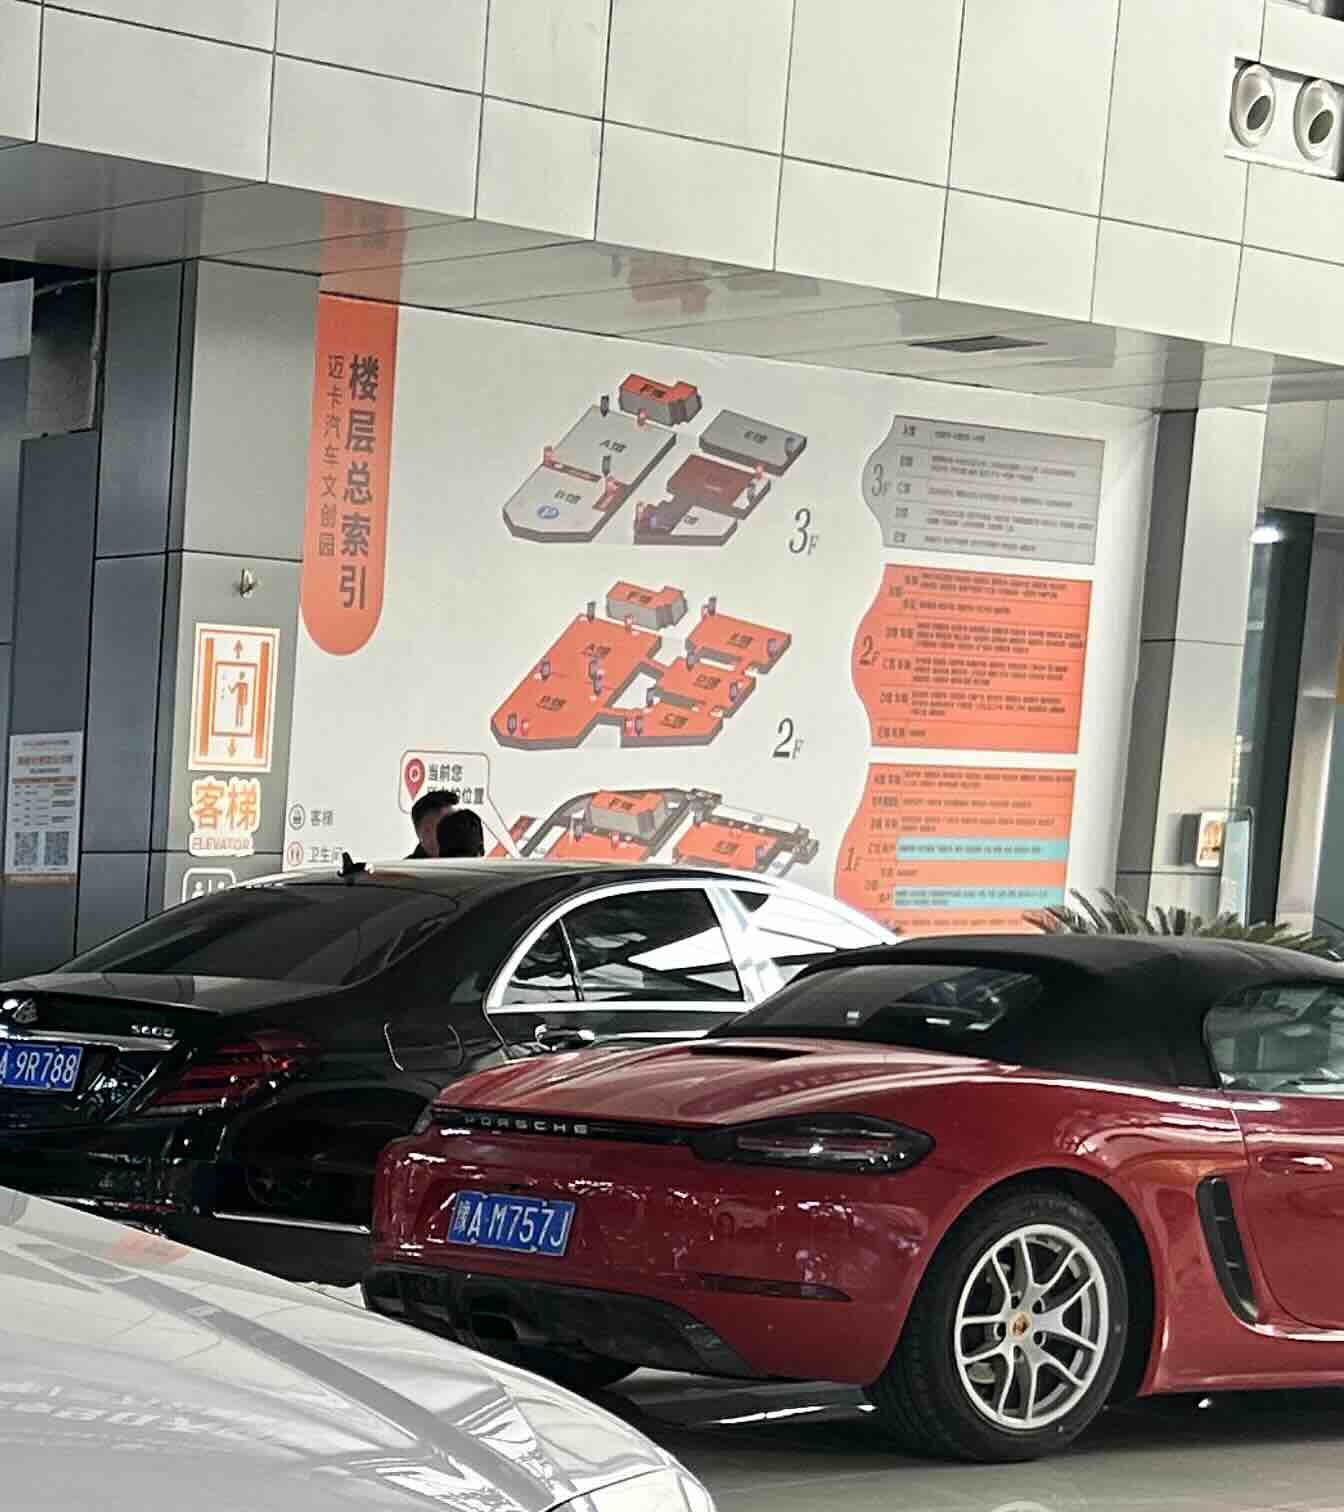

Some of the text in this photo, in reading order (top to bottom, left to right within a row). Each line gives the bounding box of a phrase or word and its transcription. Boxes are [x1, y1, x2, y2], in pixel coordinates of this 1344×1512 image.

[317, 352, 345, 558] 迈卡汽车文创园
[339, 353, 380, 611] 楼层总索引
[789, 507, 820, 556] 3F
[772, 717, 805, 759] 2F
[193, 780, 258, 831] 客梯
[191, 836, 250, 851] ELEVATOR
[464, 1114, 589, 1135] PORSCHE
